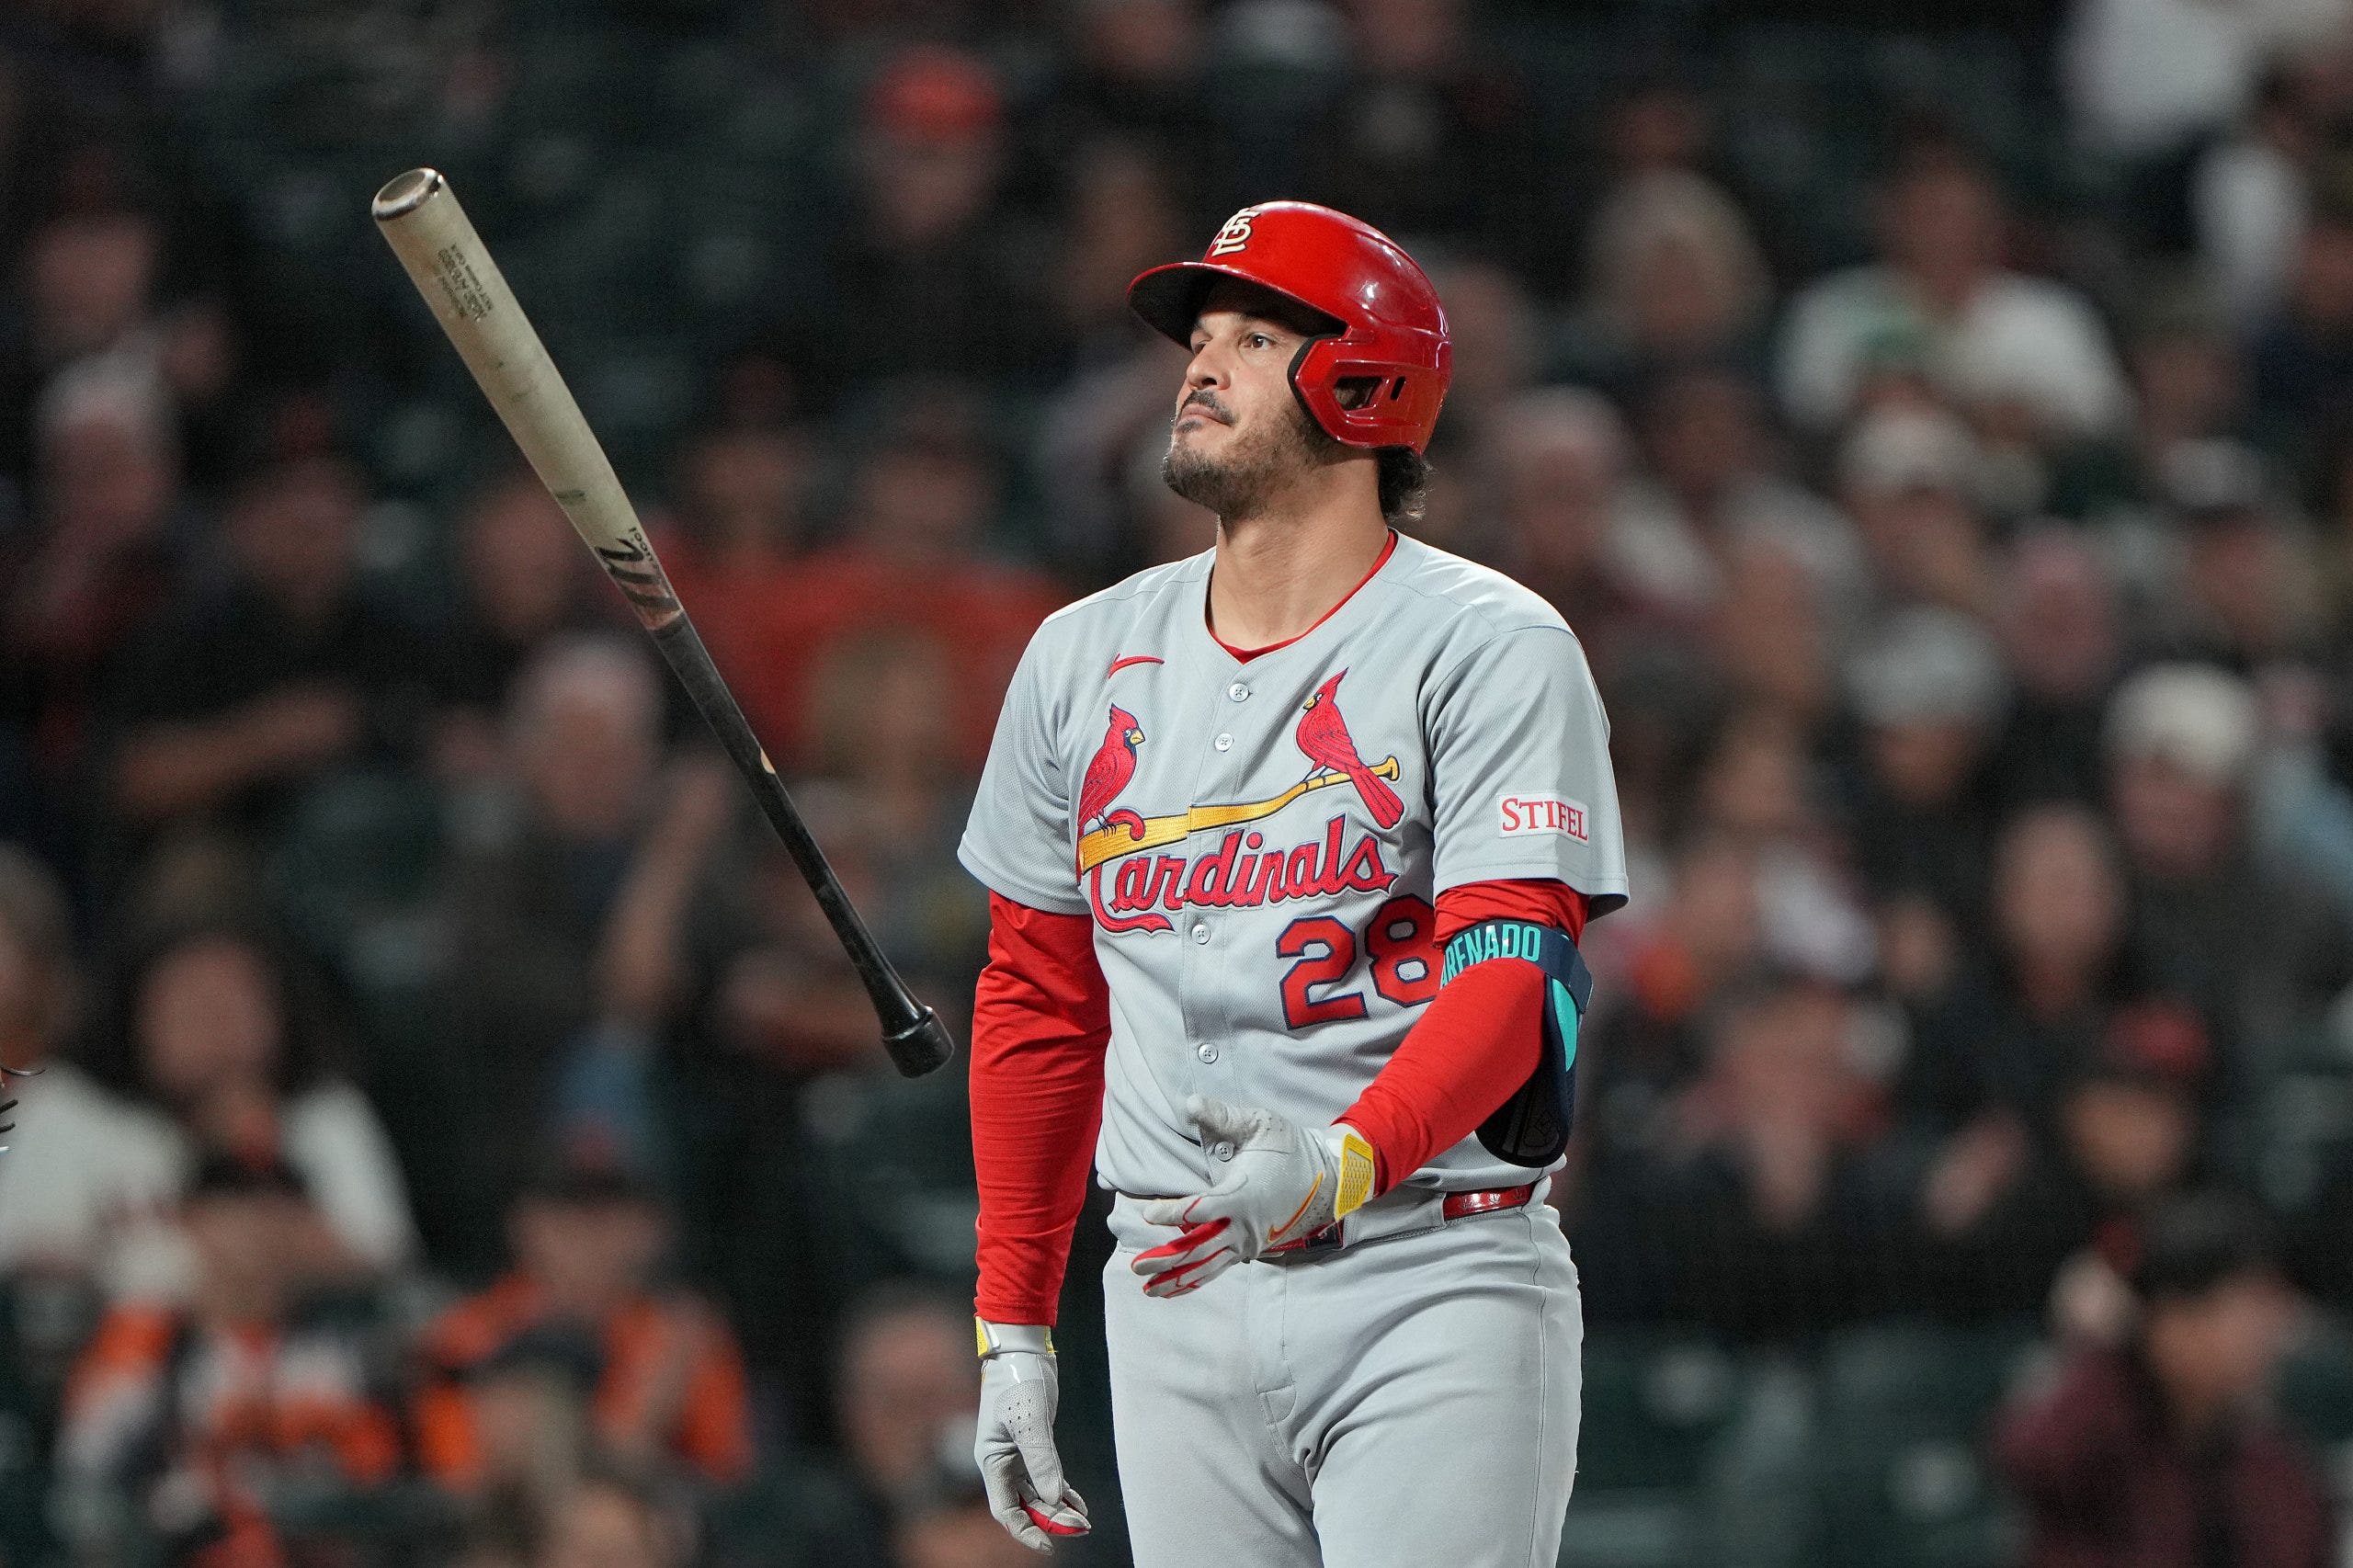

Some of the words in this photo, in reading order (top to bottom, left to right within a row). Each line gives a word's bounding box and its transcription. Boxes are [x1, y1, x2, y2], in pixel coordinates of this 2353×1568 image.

[1091, 809, 1399, 933] Cardinals
[1501, 798, 1588, 841] STIFEL
[1276, 892, 1437, 1030] 28
